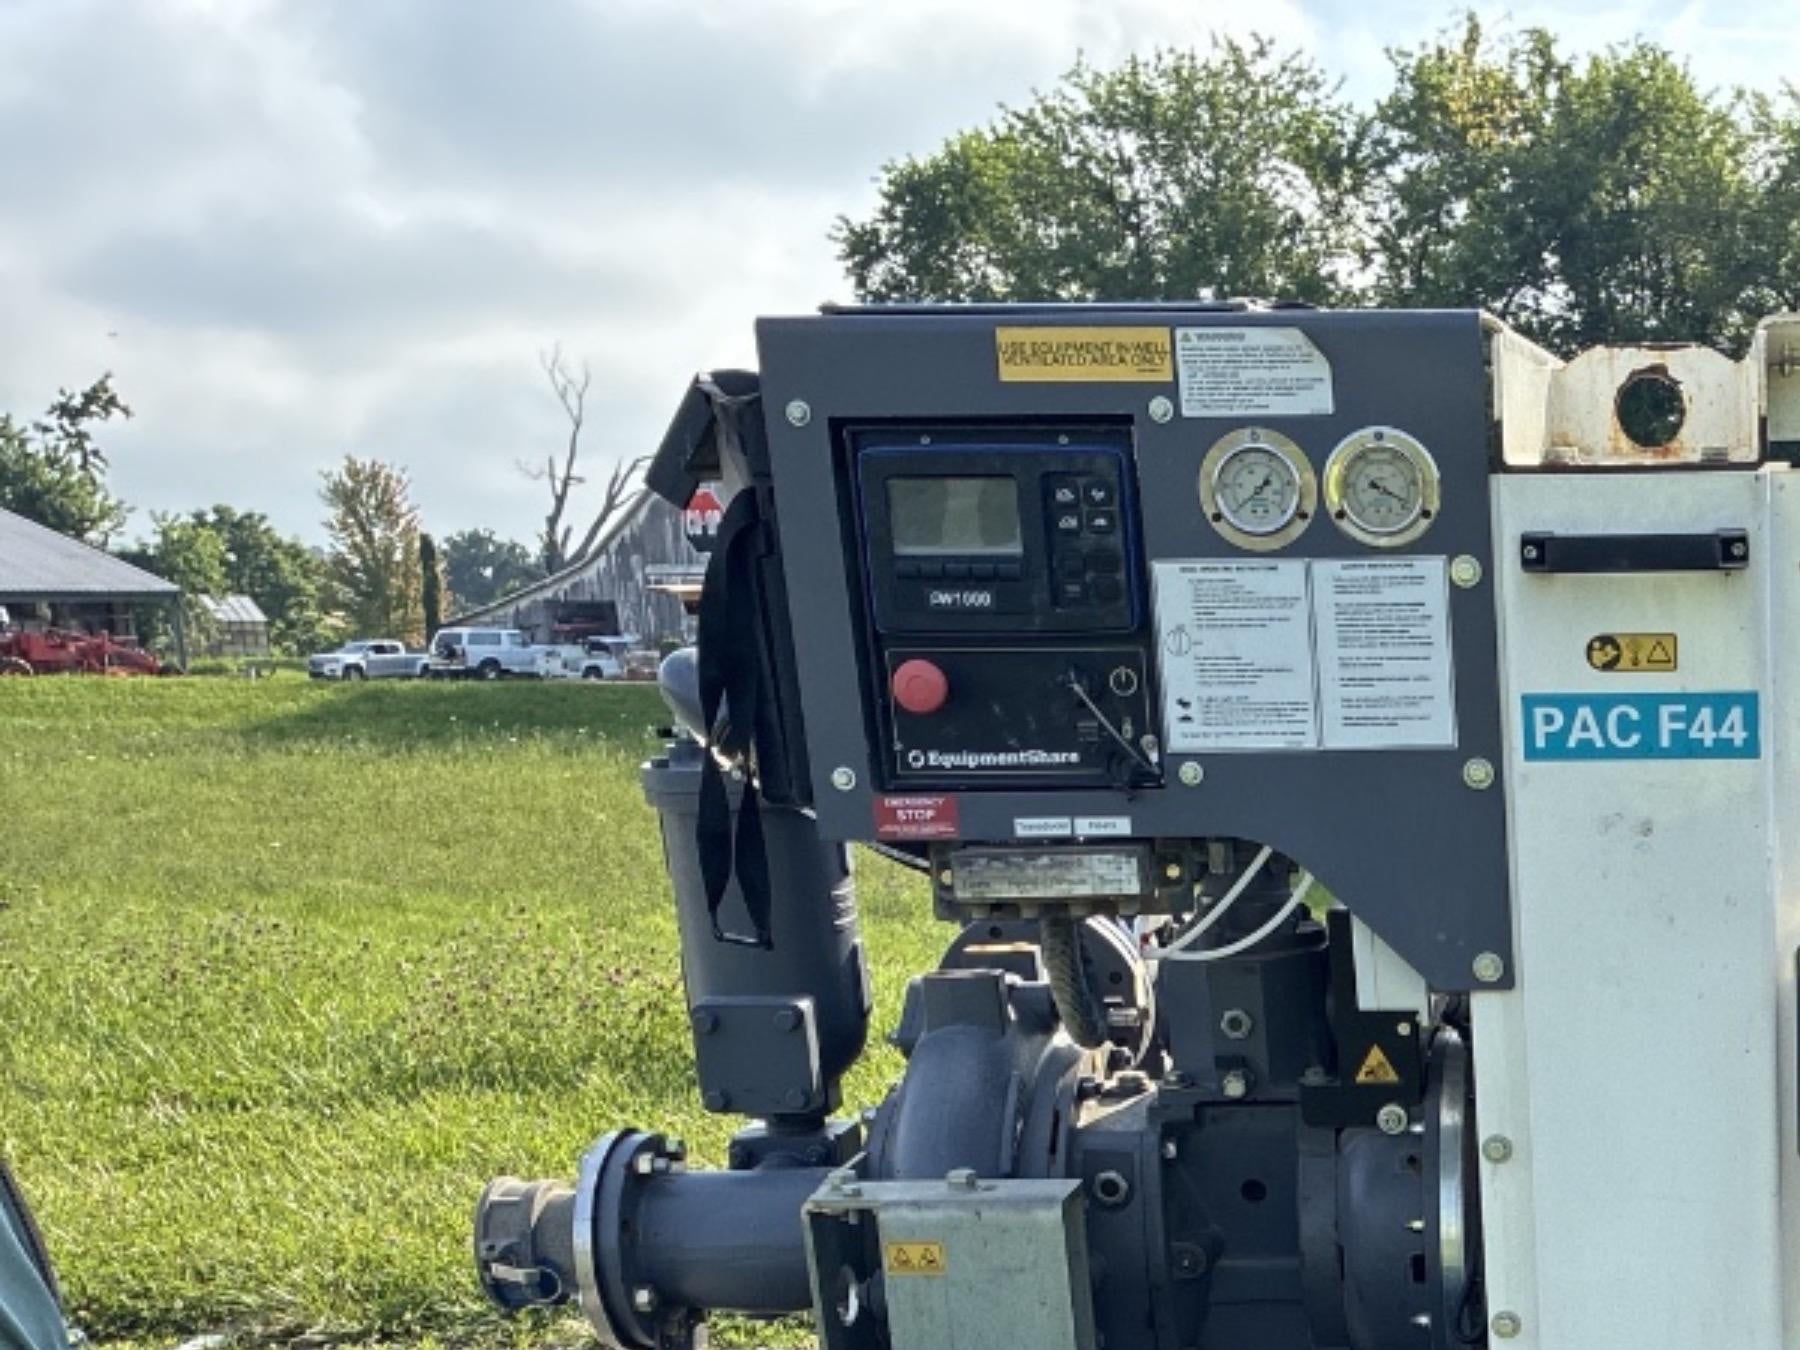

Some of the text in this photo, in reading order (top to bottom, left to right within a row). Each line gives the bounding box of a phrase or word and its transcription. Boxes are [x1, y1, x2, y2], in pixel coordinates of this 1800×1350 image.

[1000, 341, 1027, 353] USE
[1031, 341, 1113, 353] EQUIPMENT
[1002, 353, 1167, 366] VENTILATED AREA ONLY
[1532, 704, 1749, 749] PAC F44
[927, 749, 1080, 769] EquipmentShare
[895, 808, 937, 821] STOP
